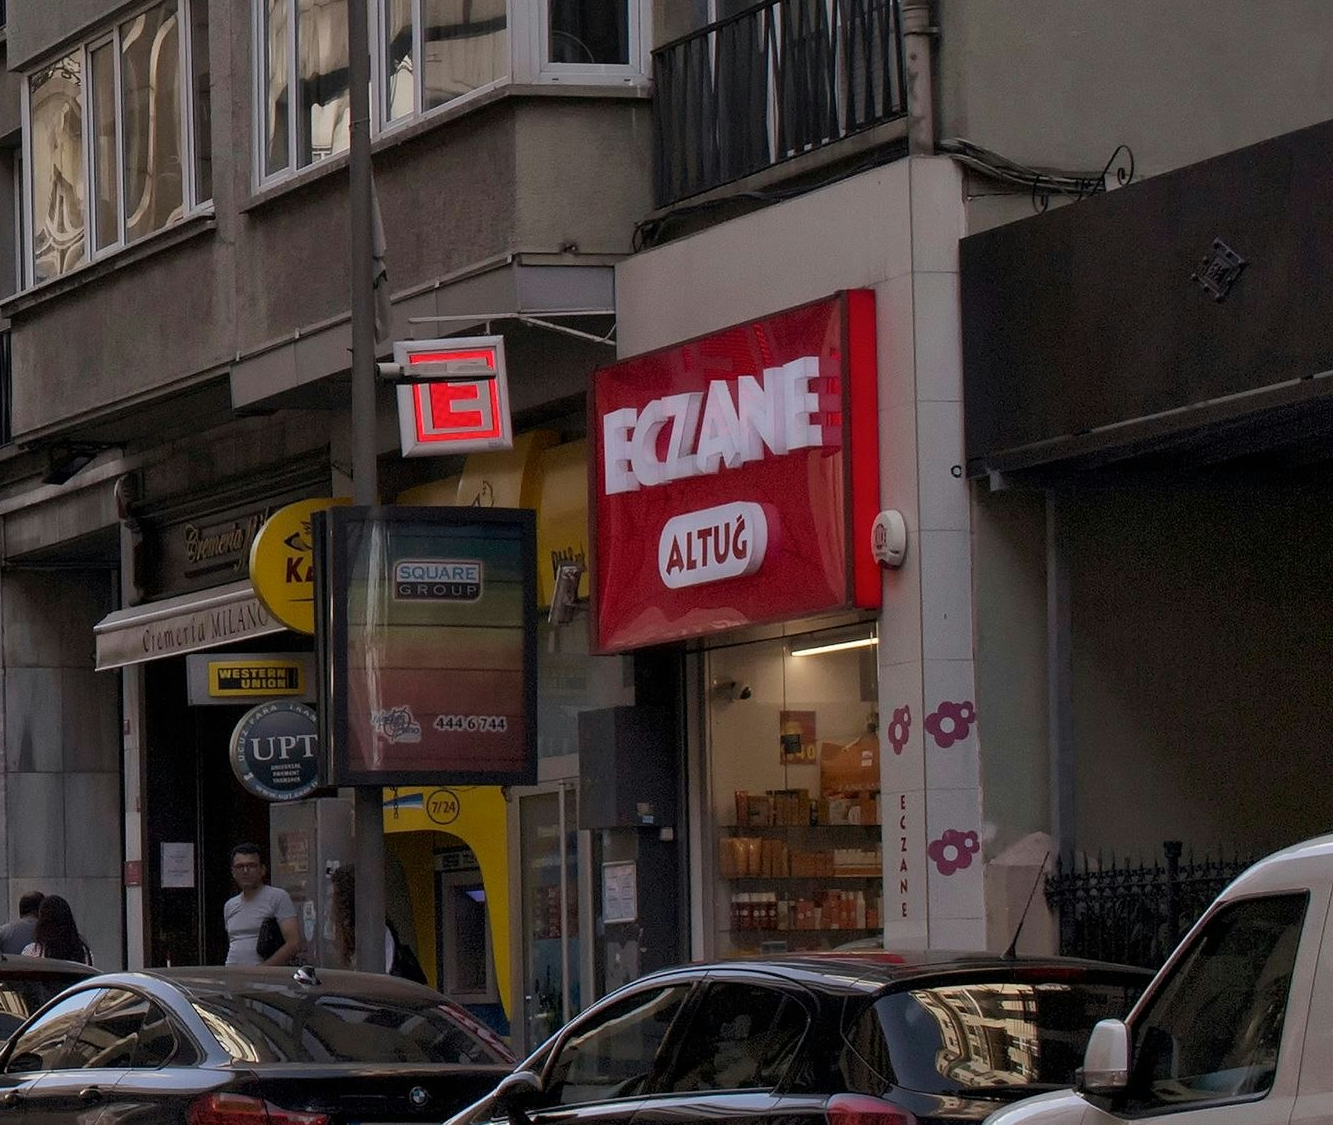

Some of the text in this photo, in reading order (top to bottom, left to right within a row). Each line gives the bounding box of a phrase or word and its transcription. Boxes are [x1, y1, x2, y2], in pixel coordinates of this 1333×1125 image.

[603, 356, 824, 495] ECZANE
[399, 565, 478, 581] SQUARE
[399, 585, 478, 595] GROUP
[142, 617, 206, 652] Cremeria
[219, 668, 286, 679] WESTERN
[240, 678, 287, 689] UNION
[436, 717, 506, 730] 444 6 744
[250, 734, 318, 761] UPT
[432, 800, 457, 813] 7/24
[899, 795, 908, 918] ECZANE
